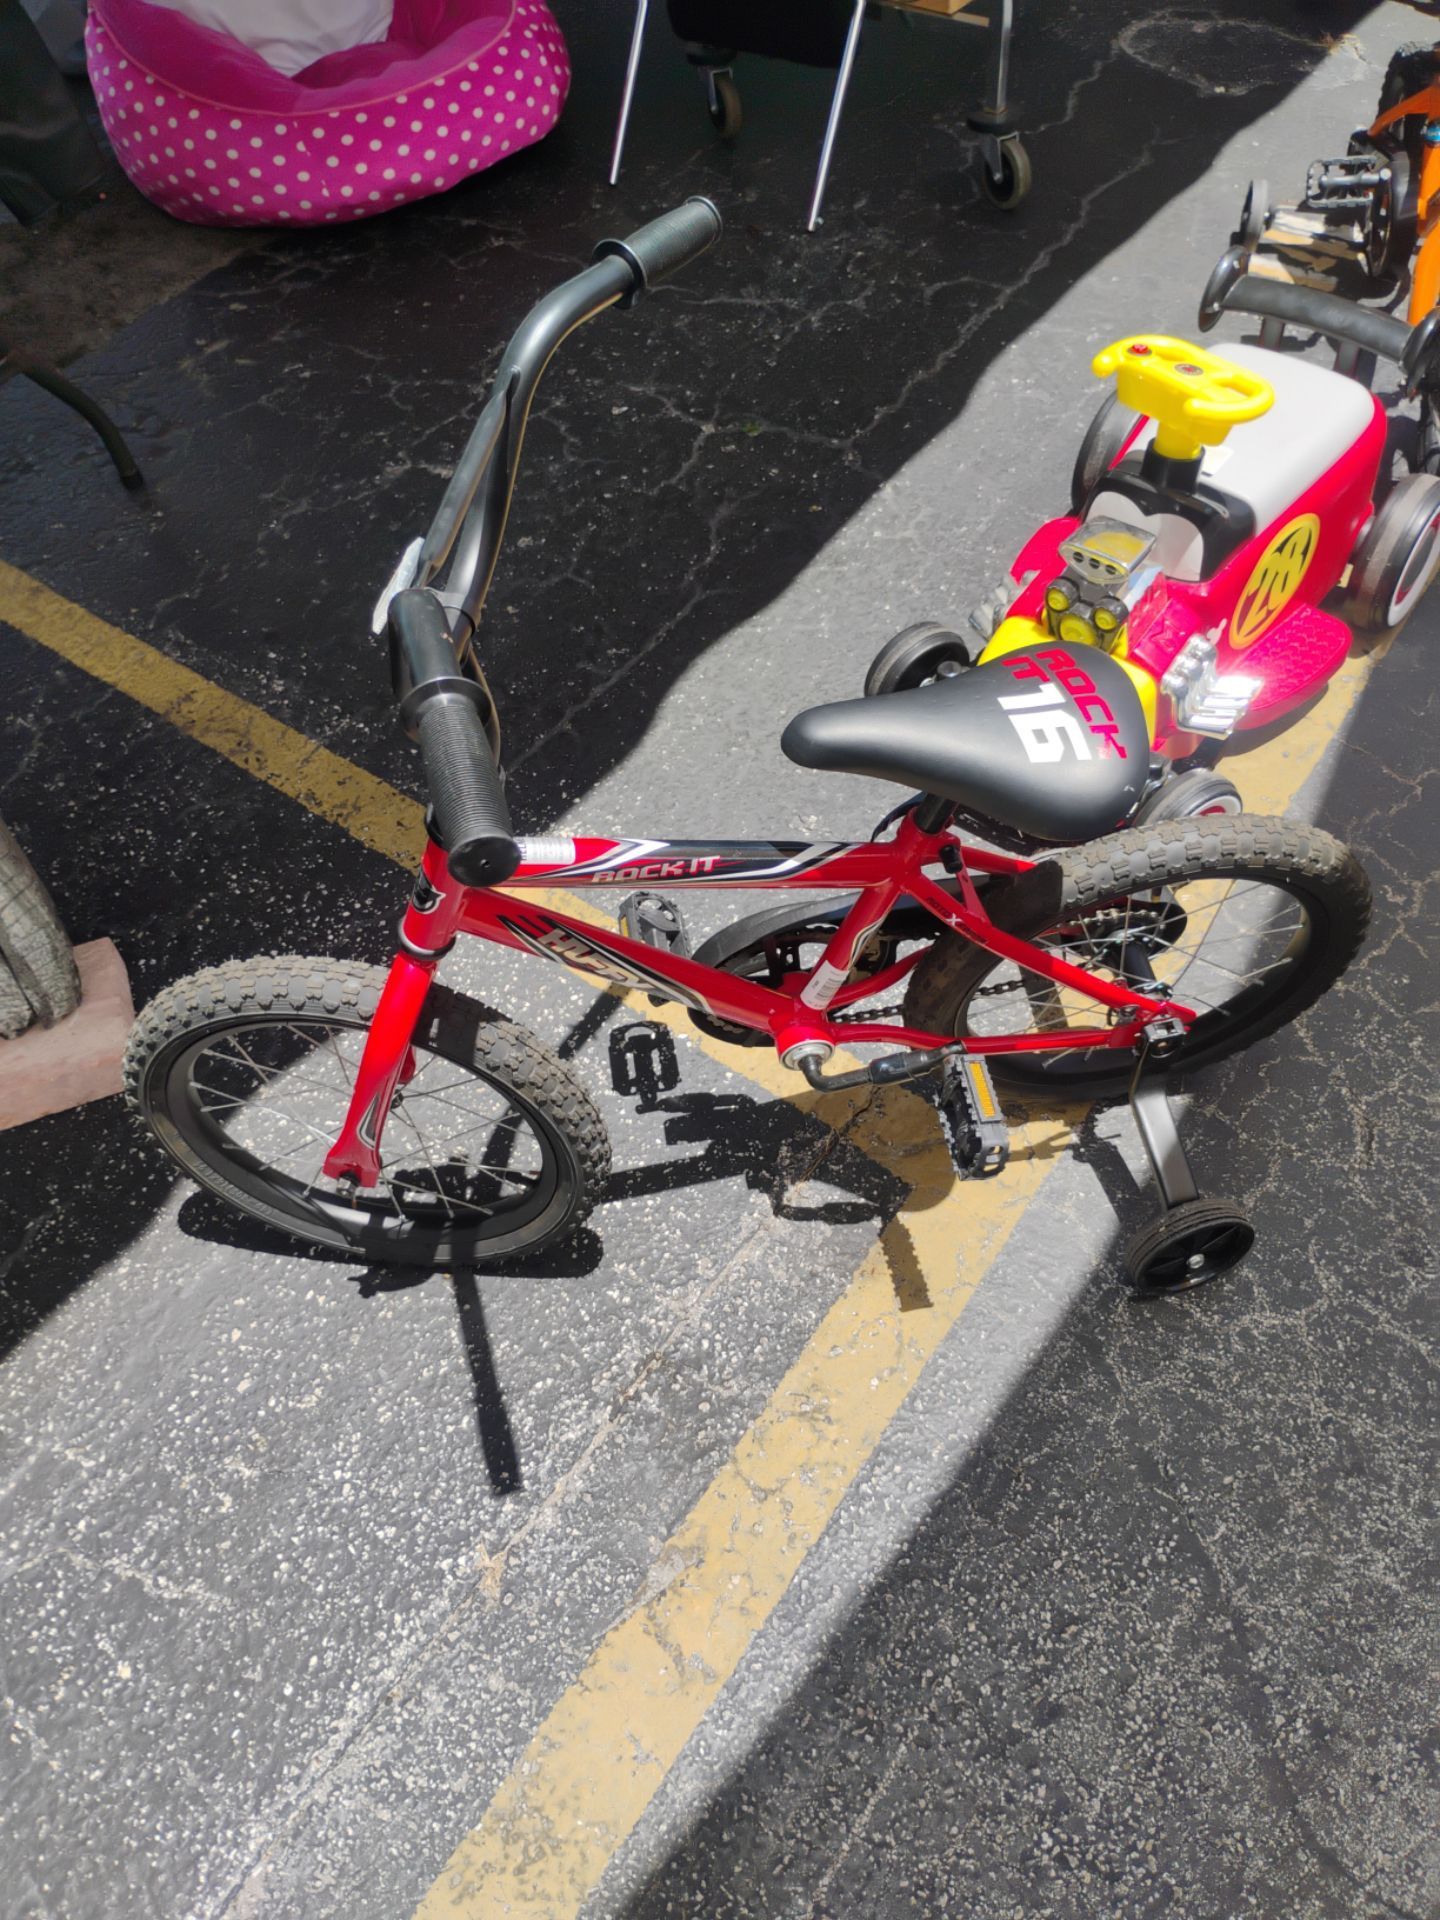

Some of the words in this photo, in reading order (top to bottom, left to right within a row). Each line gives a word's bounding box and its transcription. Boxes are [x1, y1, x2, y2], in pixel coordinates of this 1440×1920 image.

[1001, 655, 1051, 683] IT
[997, 682, 1093, 763] 16
[1036, 648, 1128, 760] ROCK
[591, 860, 685, 883] ROCK
[689, 855, 720, 874] IT
